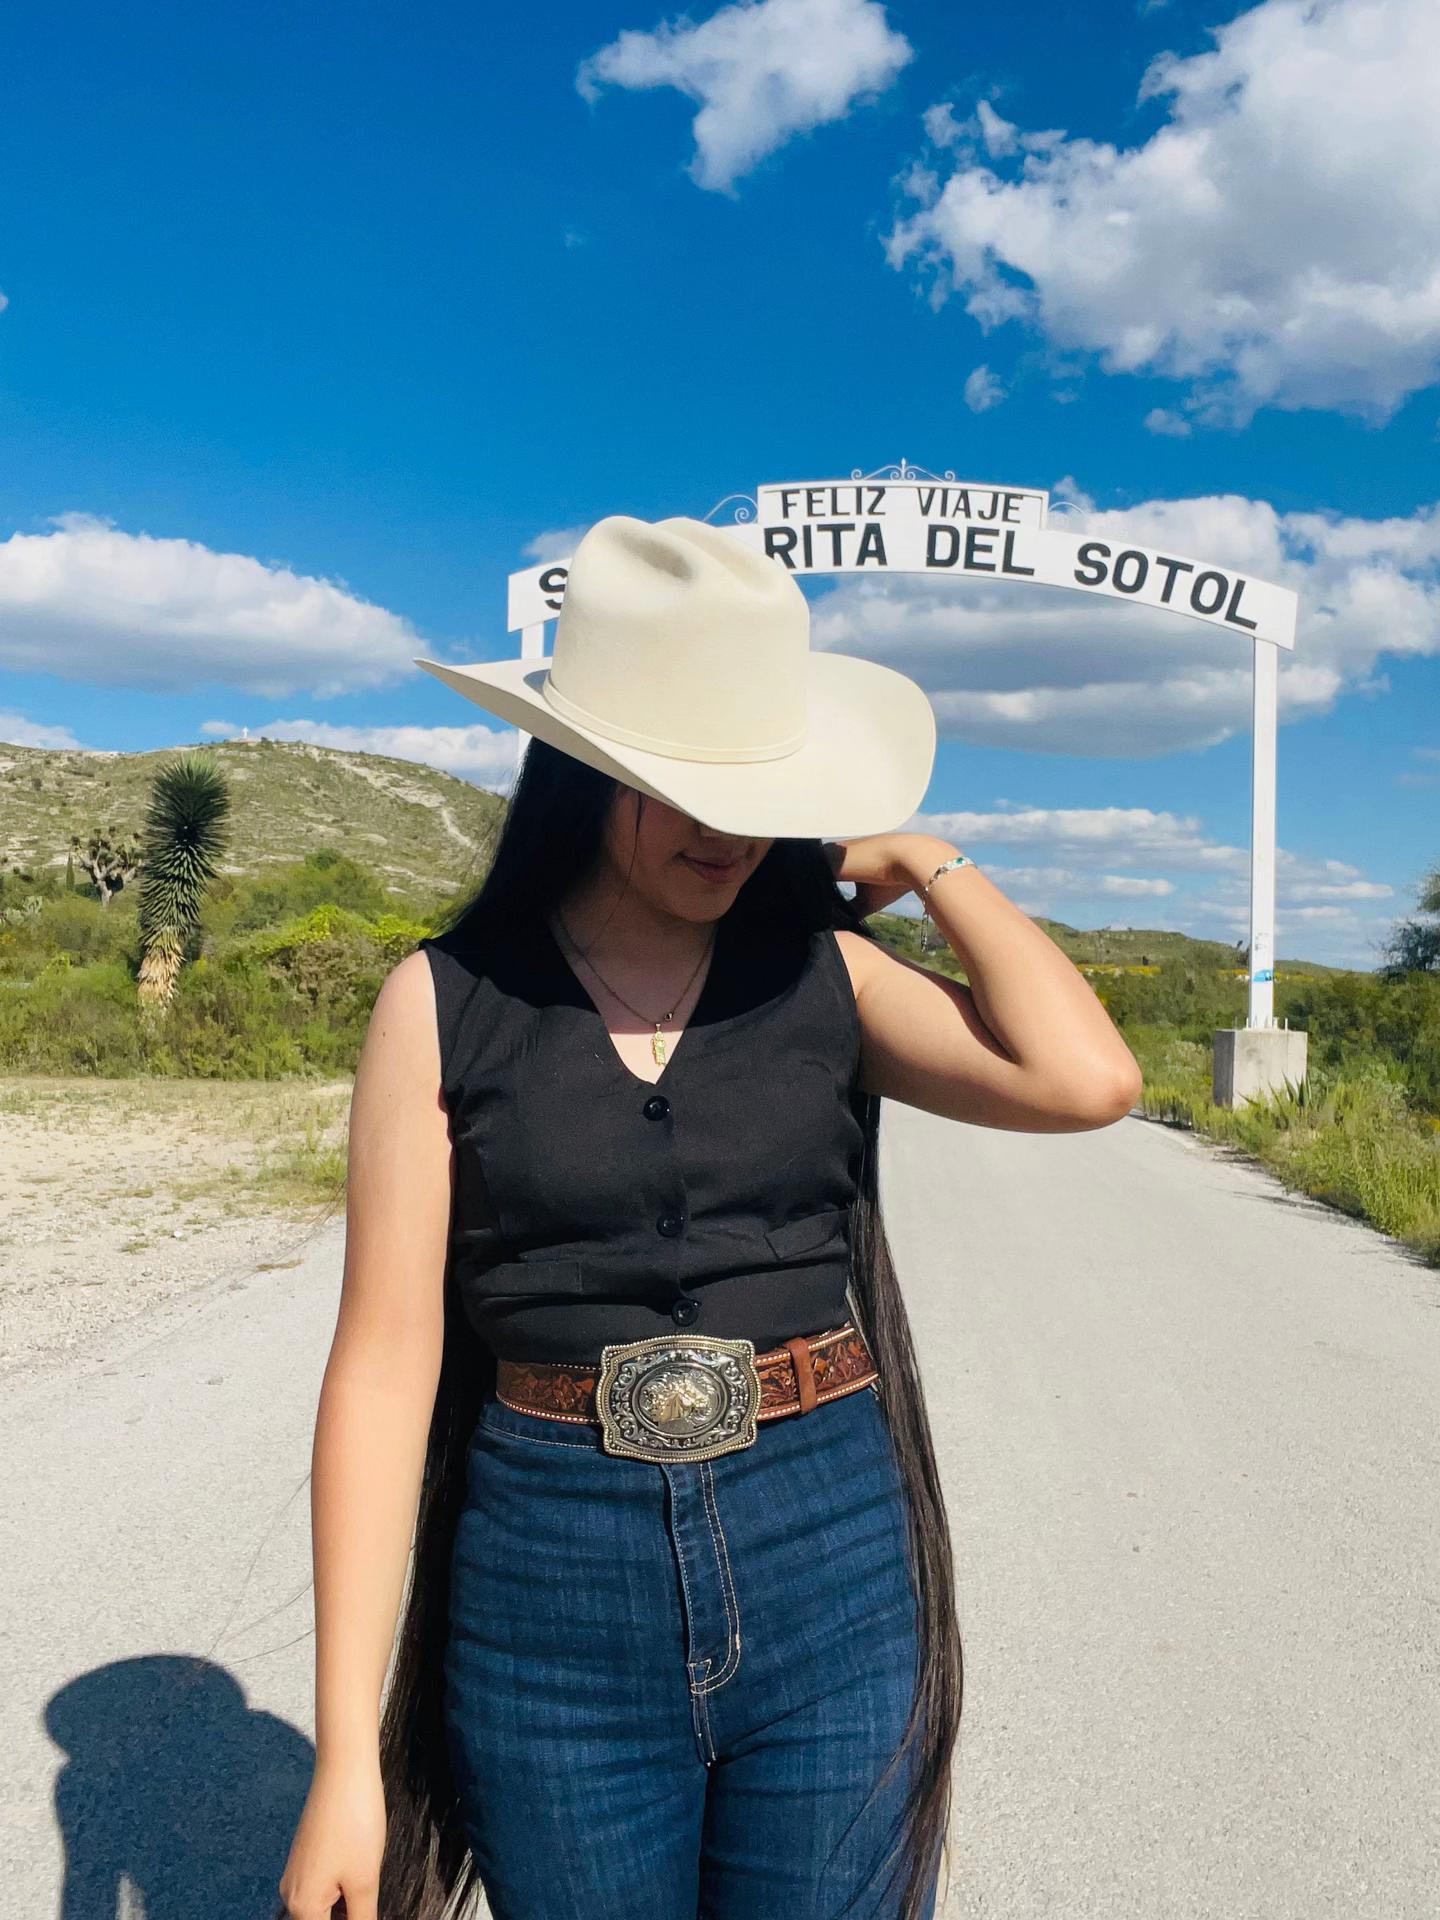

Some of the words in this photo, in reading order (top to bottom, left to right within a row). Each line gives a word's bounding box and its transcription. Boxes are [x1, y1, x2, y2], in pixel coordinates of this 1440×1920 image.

[782, 487, 887, 519] FELIZ
[917, 487, 1024, 524] VIAJE
[764, 522, 888, 569] RITA
[926, 523, 1035, 576] DEL
[1074, 541, 1258, 631] SOTOL
